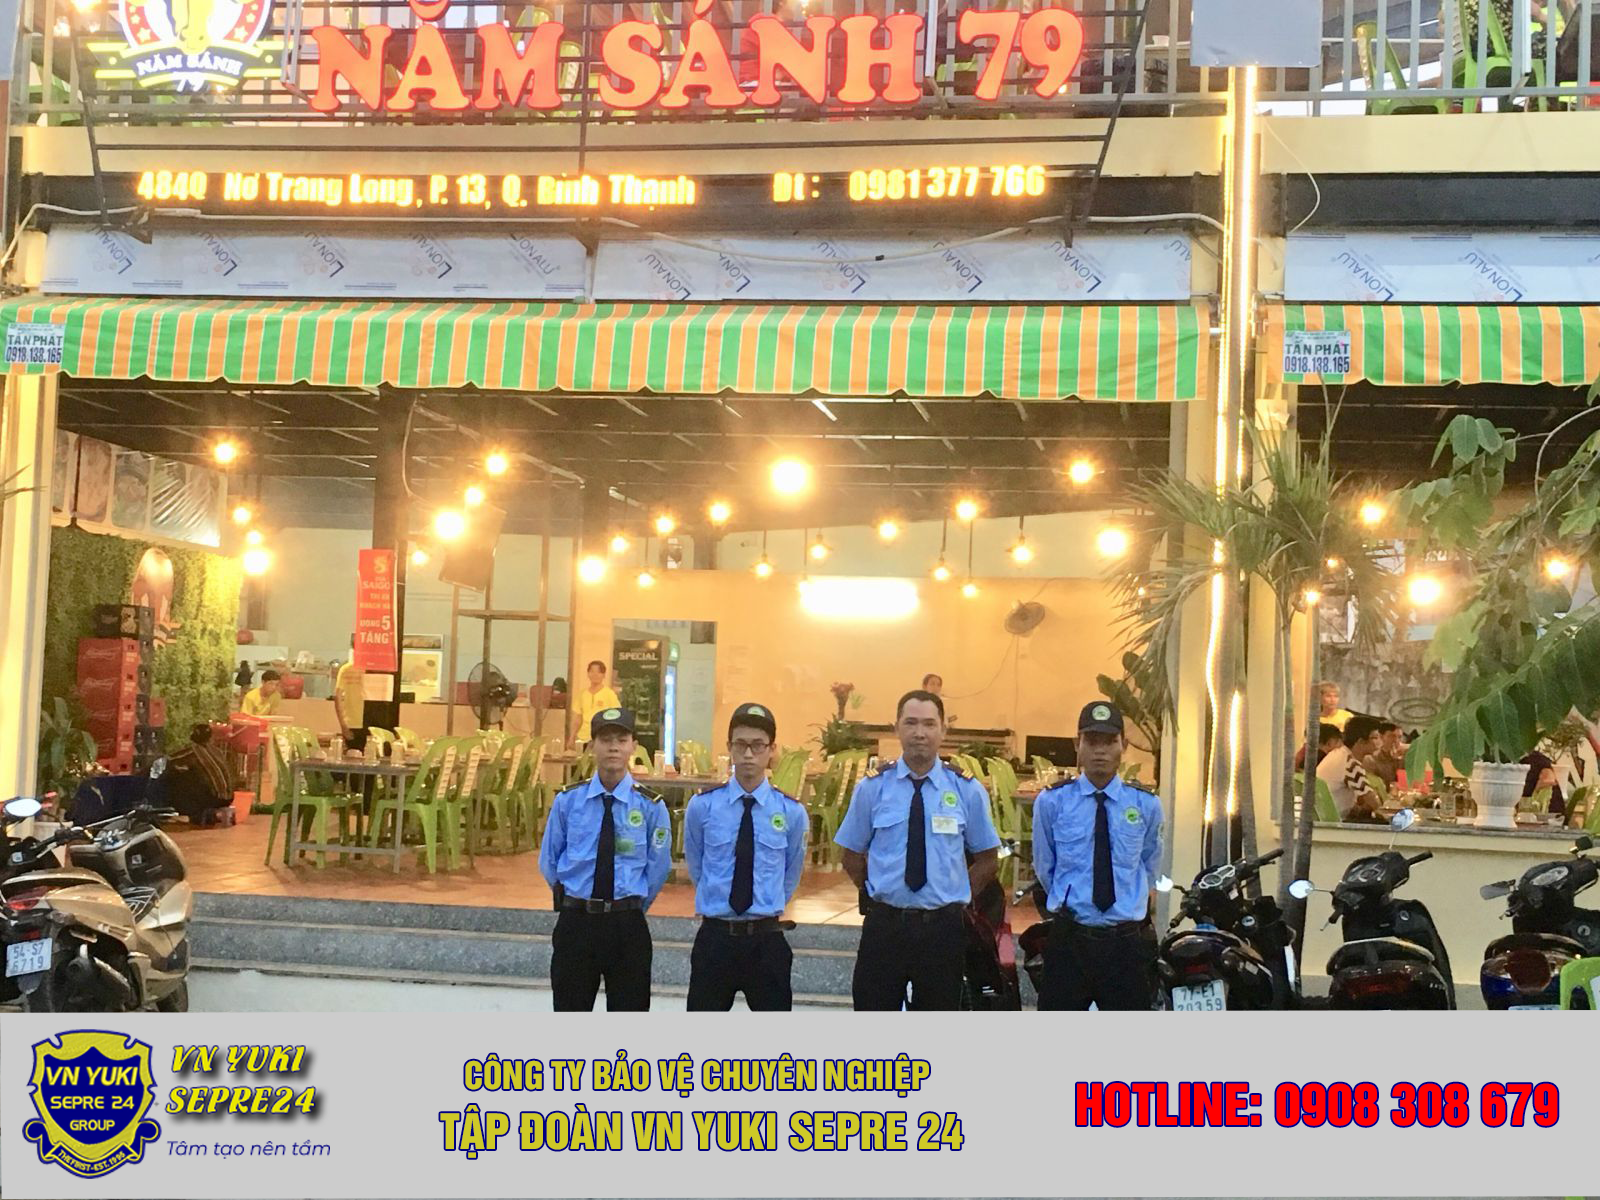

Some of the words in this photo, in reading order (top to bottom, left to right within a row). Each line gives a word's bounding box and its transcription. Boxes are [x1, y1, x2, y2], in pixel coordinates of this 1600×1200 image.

[599, 0, 925, 109] SÁNH
[957, 8, 1085, 101] 79
[266, 172, 343, 206] Trang
[430, 174, 449, 205] P.
[456, 173, 491, 210] 13,
[502, 174, 528, 207] Q.
[849, 168, 921, 201] 0981
[926, 165, 980, 198] 377
[989, 164, 1046, 197] 766
[816, 241, 866, 294] LIONLU
[1336, 250, 1395, 302] LIONALU
[1463, 250, 1524, 302] LIONALU
[1284, 356, 1350, 373] 0918.138.165
[381, 615, 391, 631] 5
